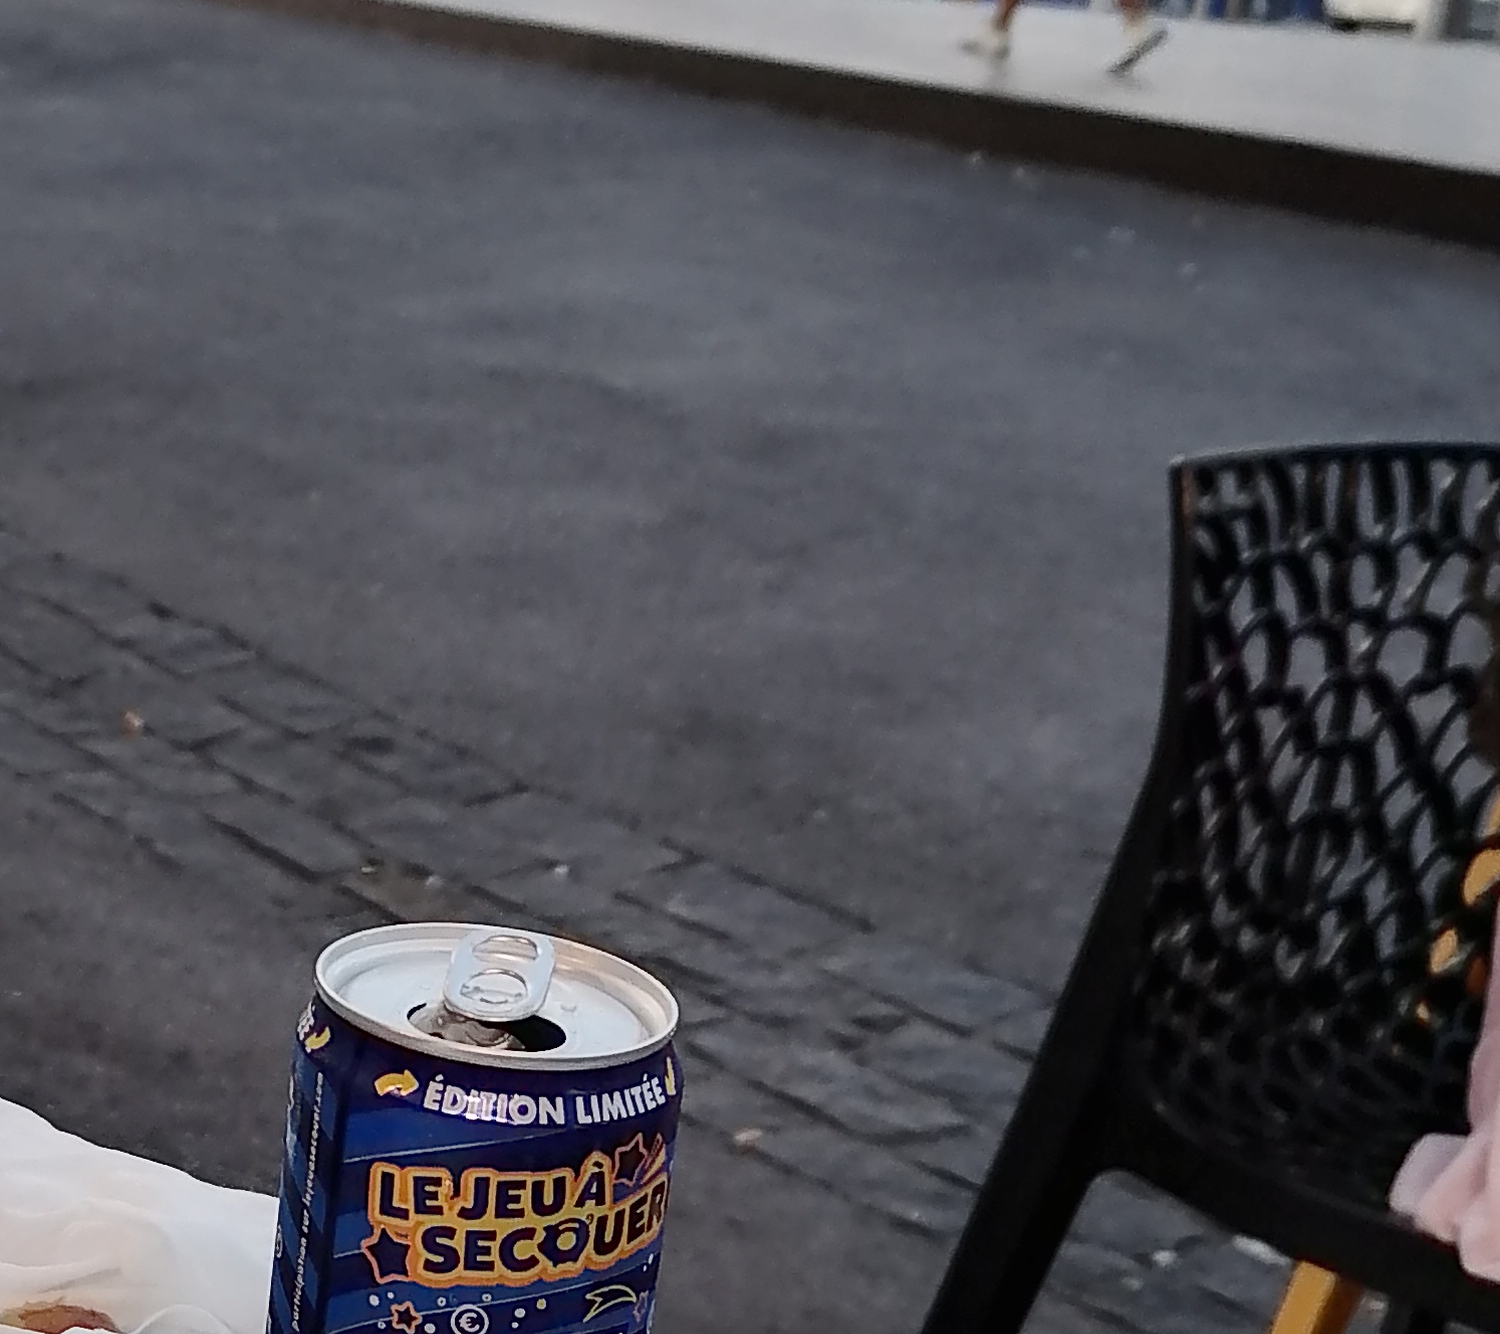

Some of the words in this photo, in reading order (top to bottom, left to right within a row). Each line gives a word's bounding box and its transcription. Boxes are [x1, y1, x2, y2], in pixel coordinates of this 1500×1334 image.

[423, 1074, 566, 1125] ÉDITION
[576, 1072, 667, 1125] LIMITÉE
[377, 1170, 445, 1222] LE
[456, 1171, 570, 1222] JEU
[572, 1160, 609, 1210] À
[421, 1178, 666, 1273] SECOUER
